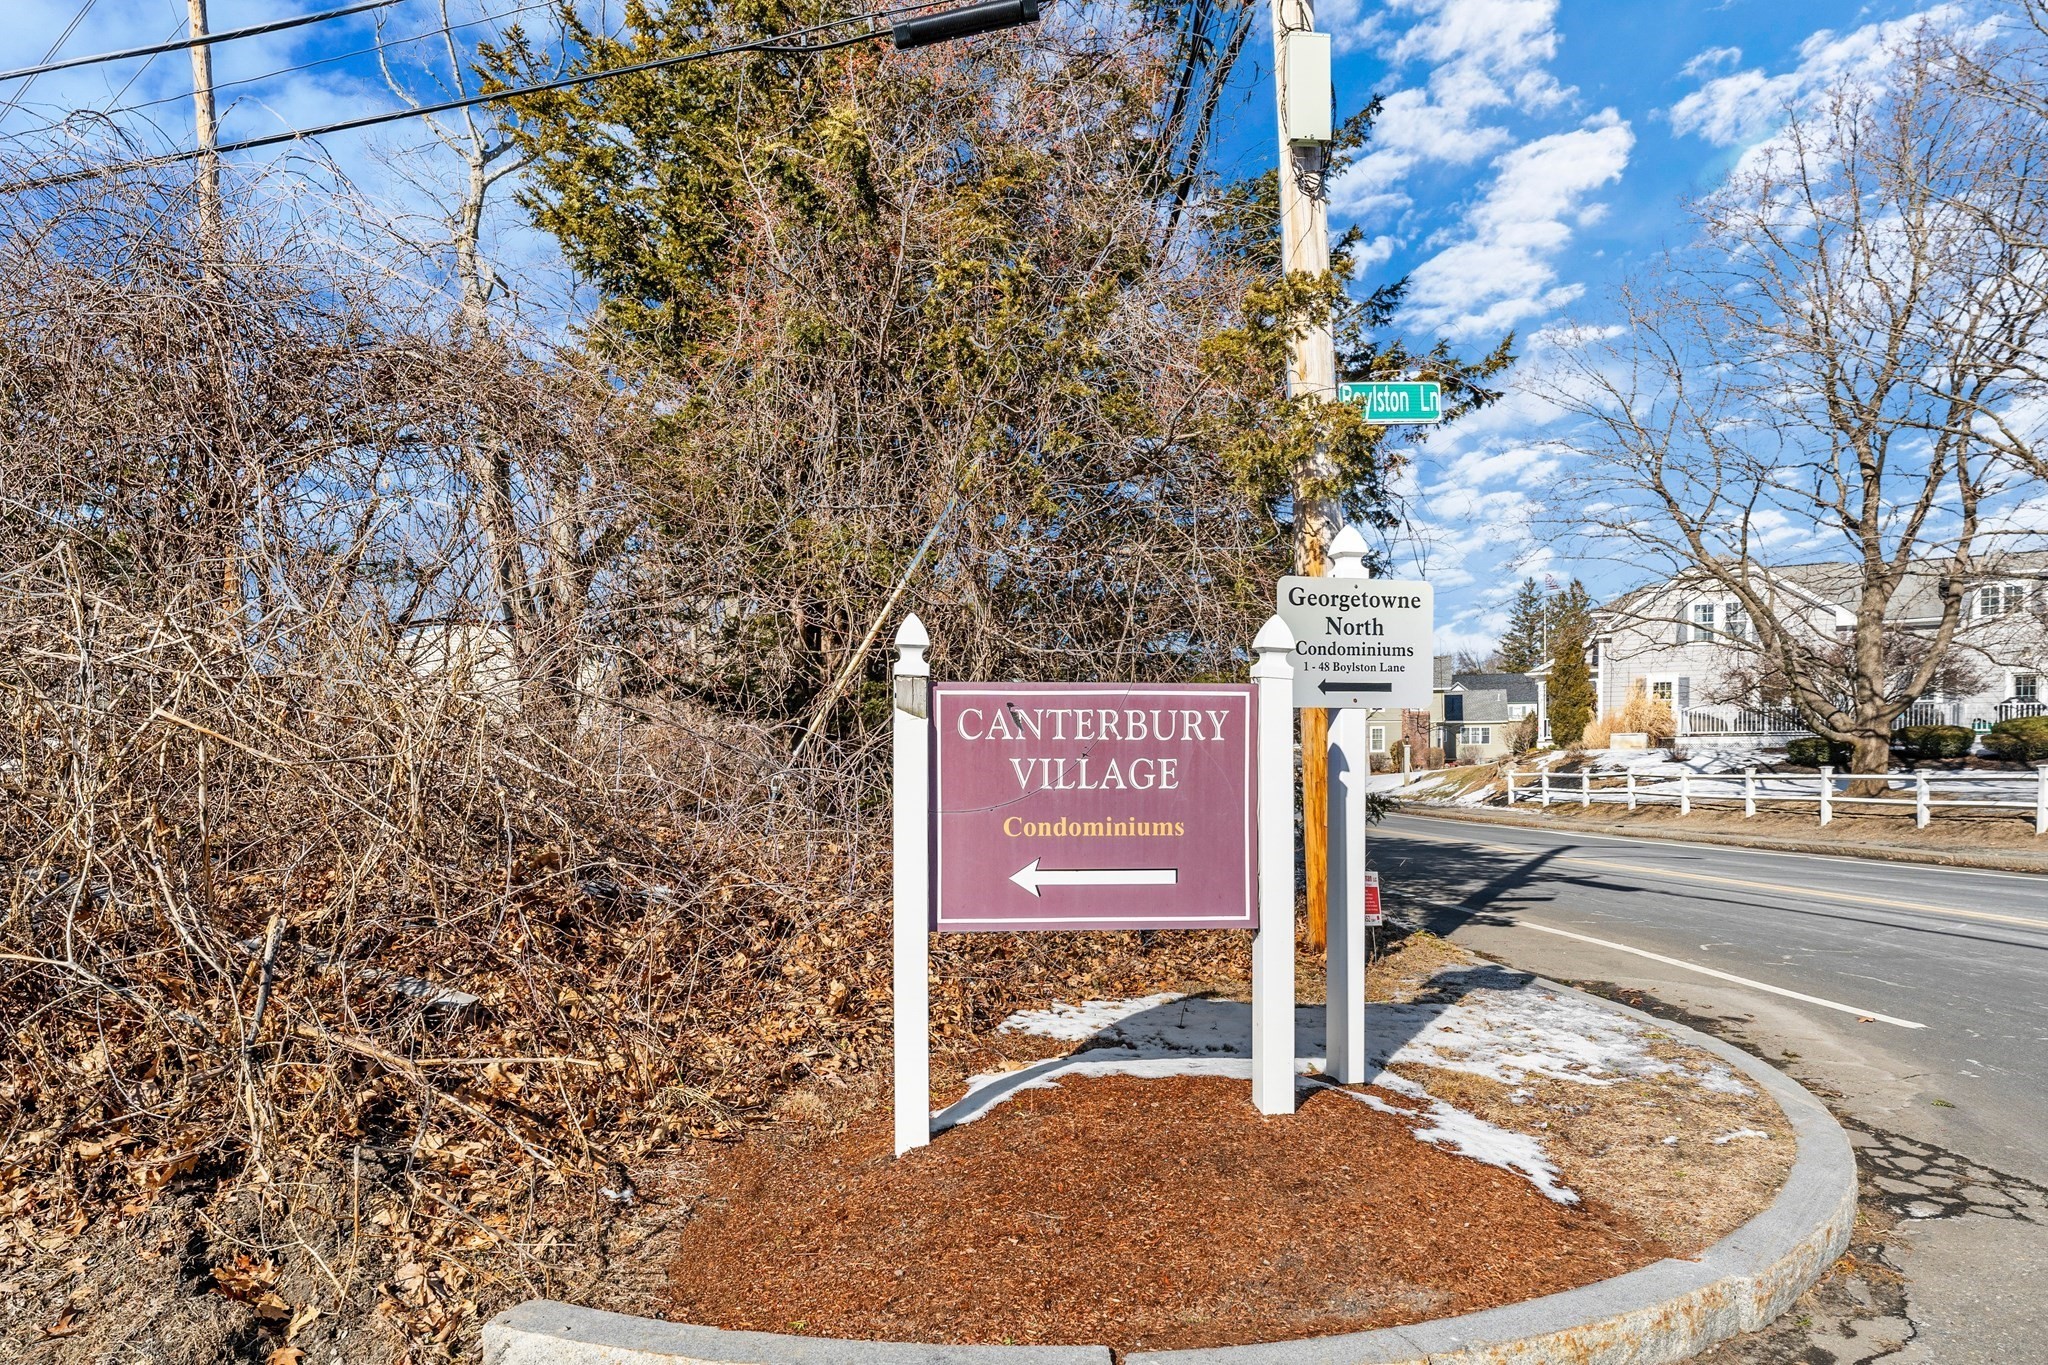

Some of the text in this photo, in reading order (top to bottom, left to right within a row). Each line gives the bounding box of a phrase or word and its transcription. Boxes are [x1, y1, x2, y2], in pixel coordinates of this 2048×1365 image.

[1421, 385, 1438, 411] Ln
[1288, 586, 1421, 612] Georgetowne
[1325, 616, 1384, 636] North
[1295, 640, 1414, 657] Condominiums
[1319, 661, 1330, 672] 48
[1333, 661, 1377, 674] Boylston
[1379, 662, 1406, 672] Lane
[957, 708, 1230, 740] CANTERBURY
[1008, 757, 1179, 790] VILLAGE
[1003, 816, 1185, 837] Condominiums
